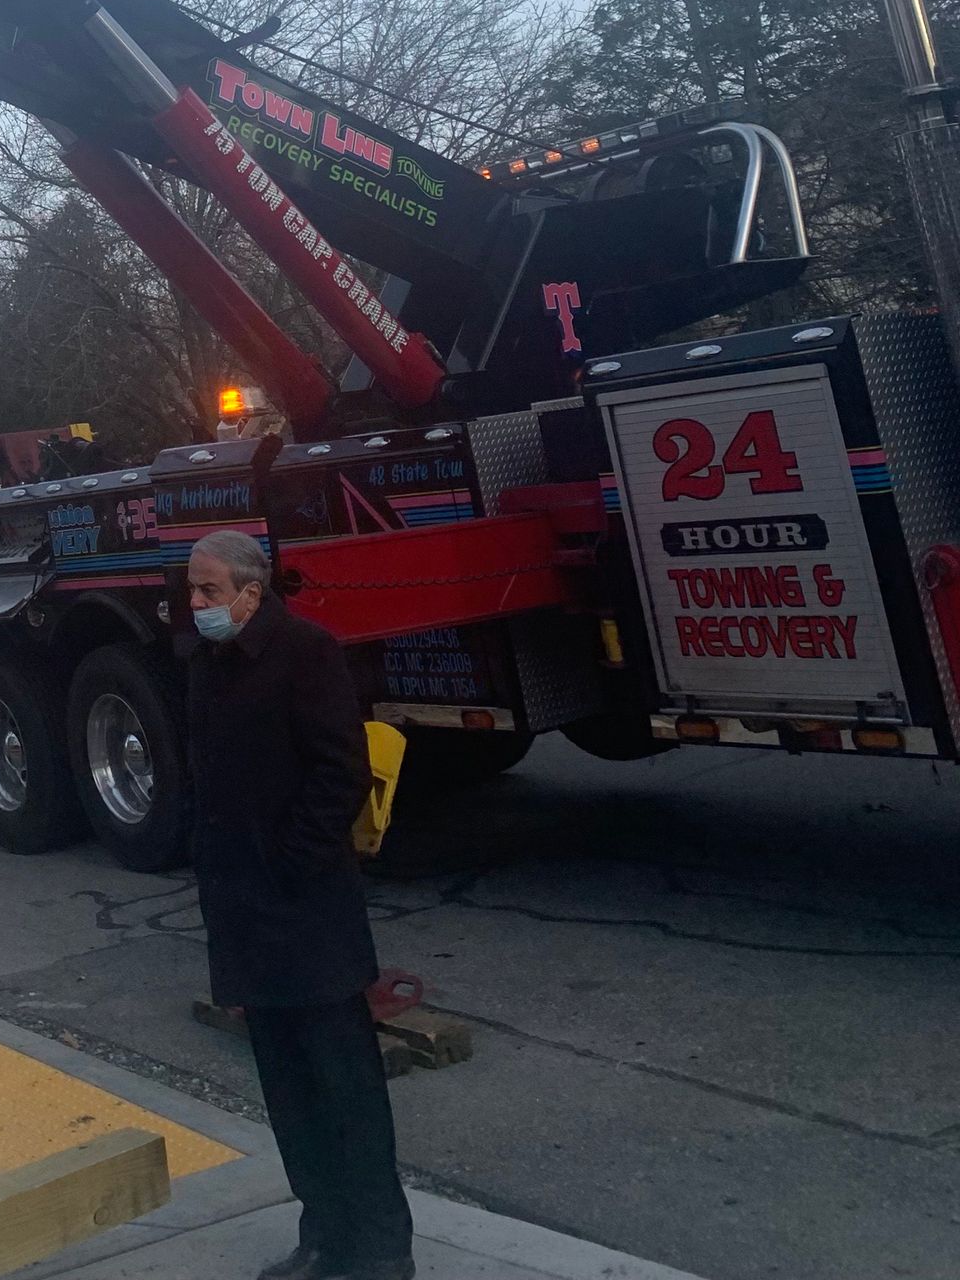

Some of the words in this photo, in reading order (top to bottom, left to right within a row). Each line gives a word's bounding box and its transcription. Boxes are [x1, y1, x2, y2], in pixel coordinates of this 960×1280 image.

[214, 59, 313, 135] TOWN
[321, 111, 392, 170] LINE
[397, 159, 444, 198] TOWING
[227, 115, 324, 171] RECOVERY
[329, 164, 438, 227] SPECIALISTS
[236, 149, 285, 212] TON
[283, 205, 333, 270] CAP.
[333, 261, 409, 353] CRANE
[391, 461, 428, 484] State
[652, 409, 804, 502] 24
[180, 481, 250, 513] Authority
[678, 521, 808, 551] HOUR
[667, 565, 807, 609] TOWING
[812, 563, 846, 608] &
[675, 615, 858, 660] RECOVERY
[404, 652, 424, 672] MC
